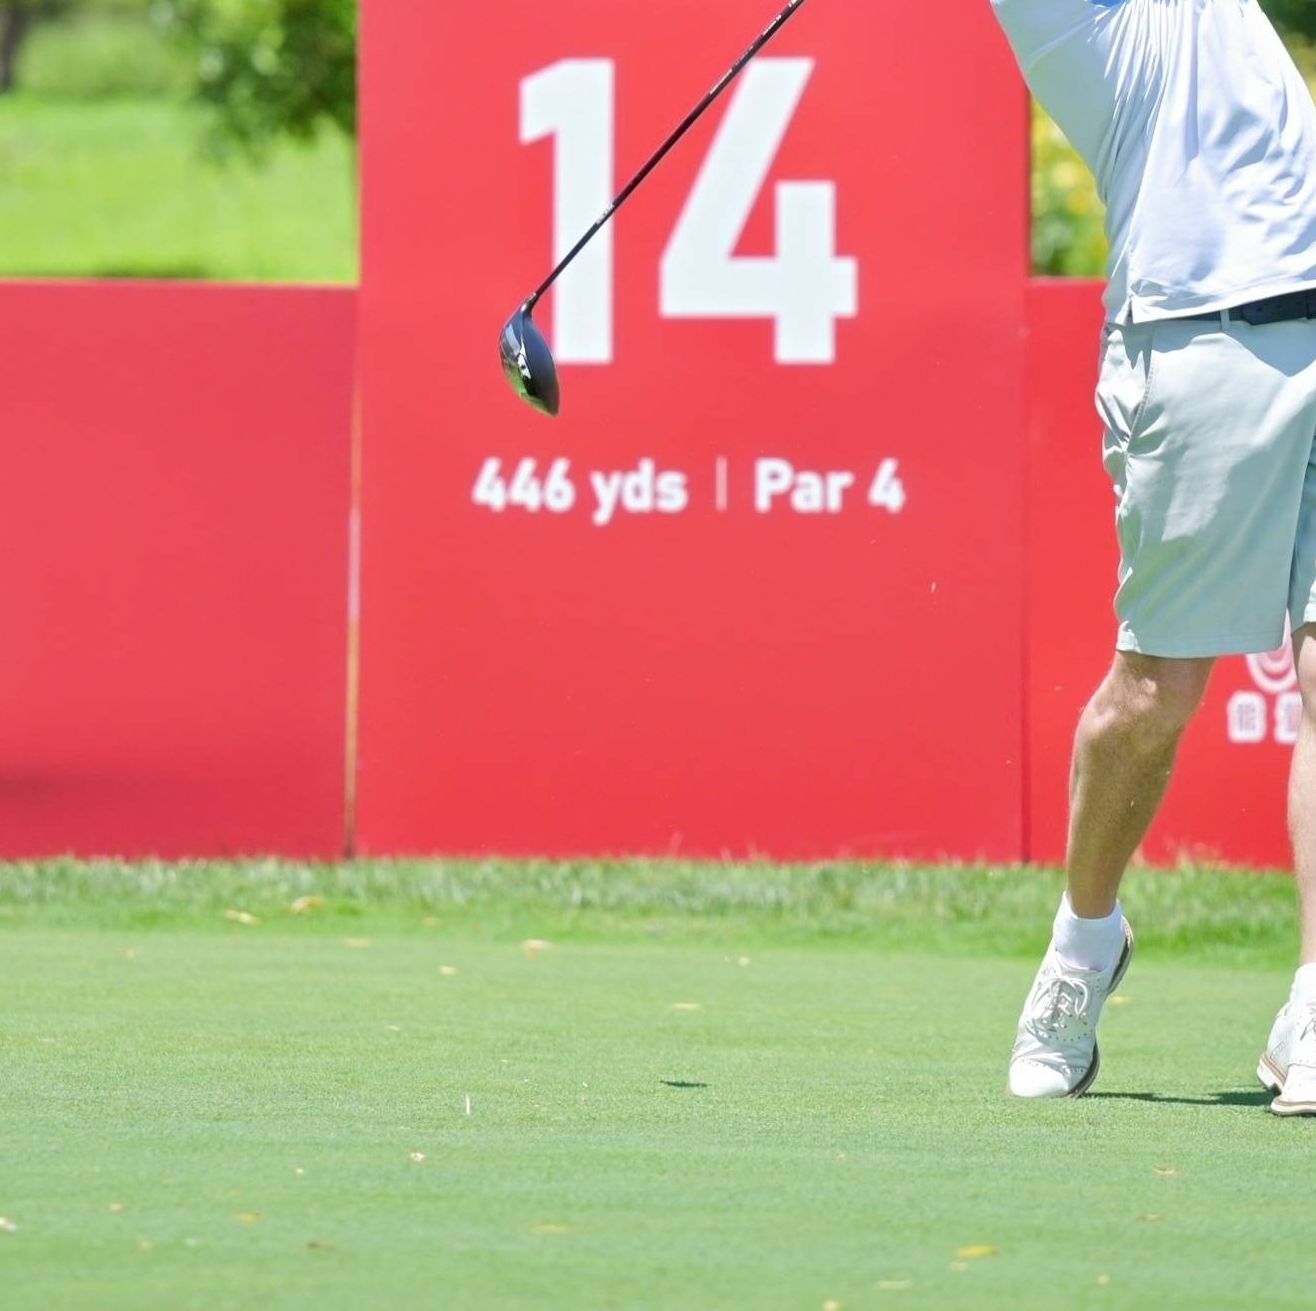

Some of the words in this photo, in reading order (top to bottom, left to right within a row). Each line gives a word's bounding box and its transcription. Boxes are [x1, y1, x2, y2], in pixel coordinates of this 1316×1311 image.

[519, 57, 859, 365] 14
[472, 457, 575, 512] 446
[590, 457, 689, 526] yds
[754, 457, 853, 512] Par
[868, 457, 905, 512] 4
